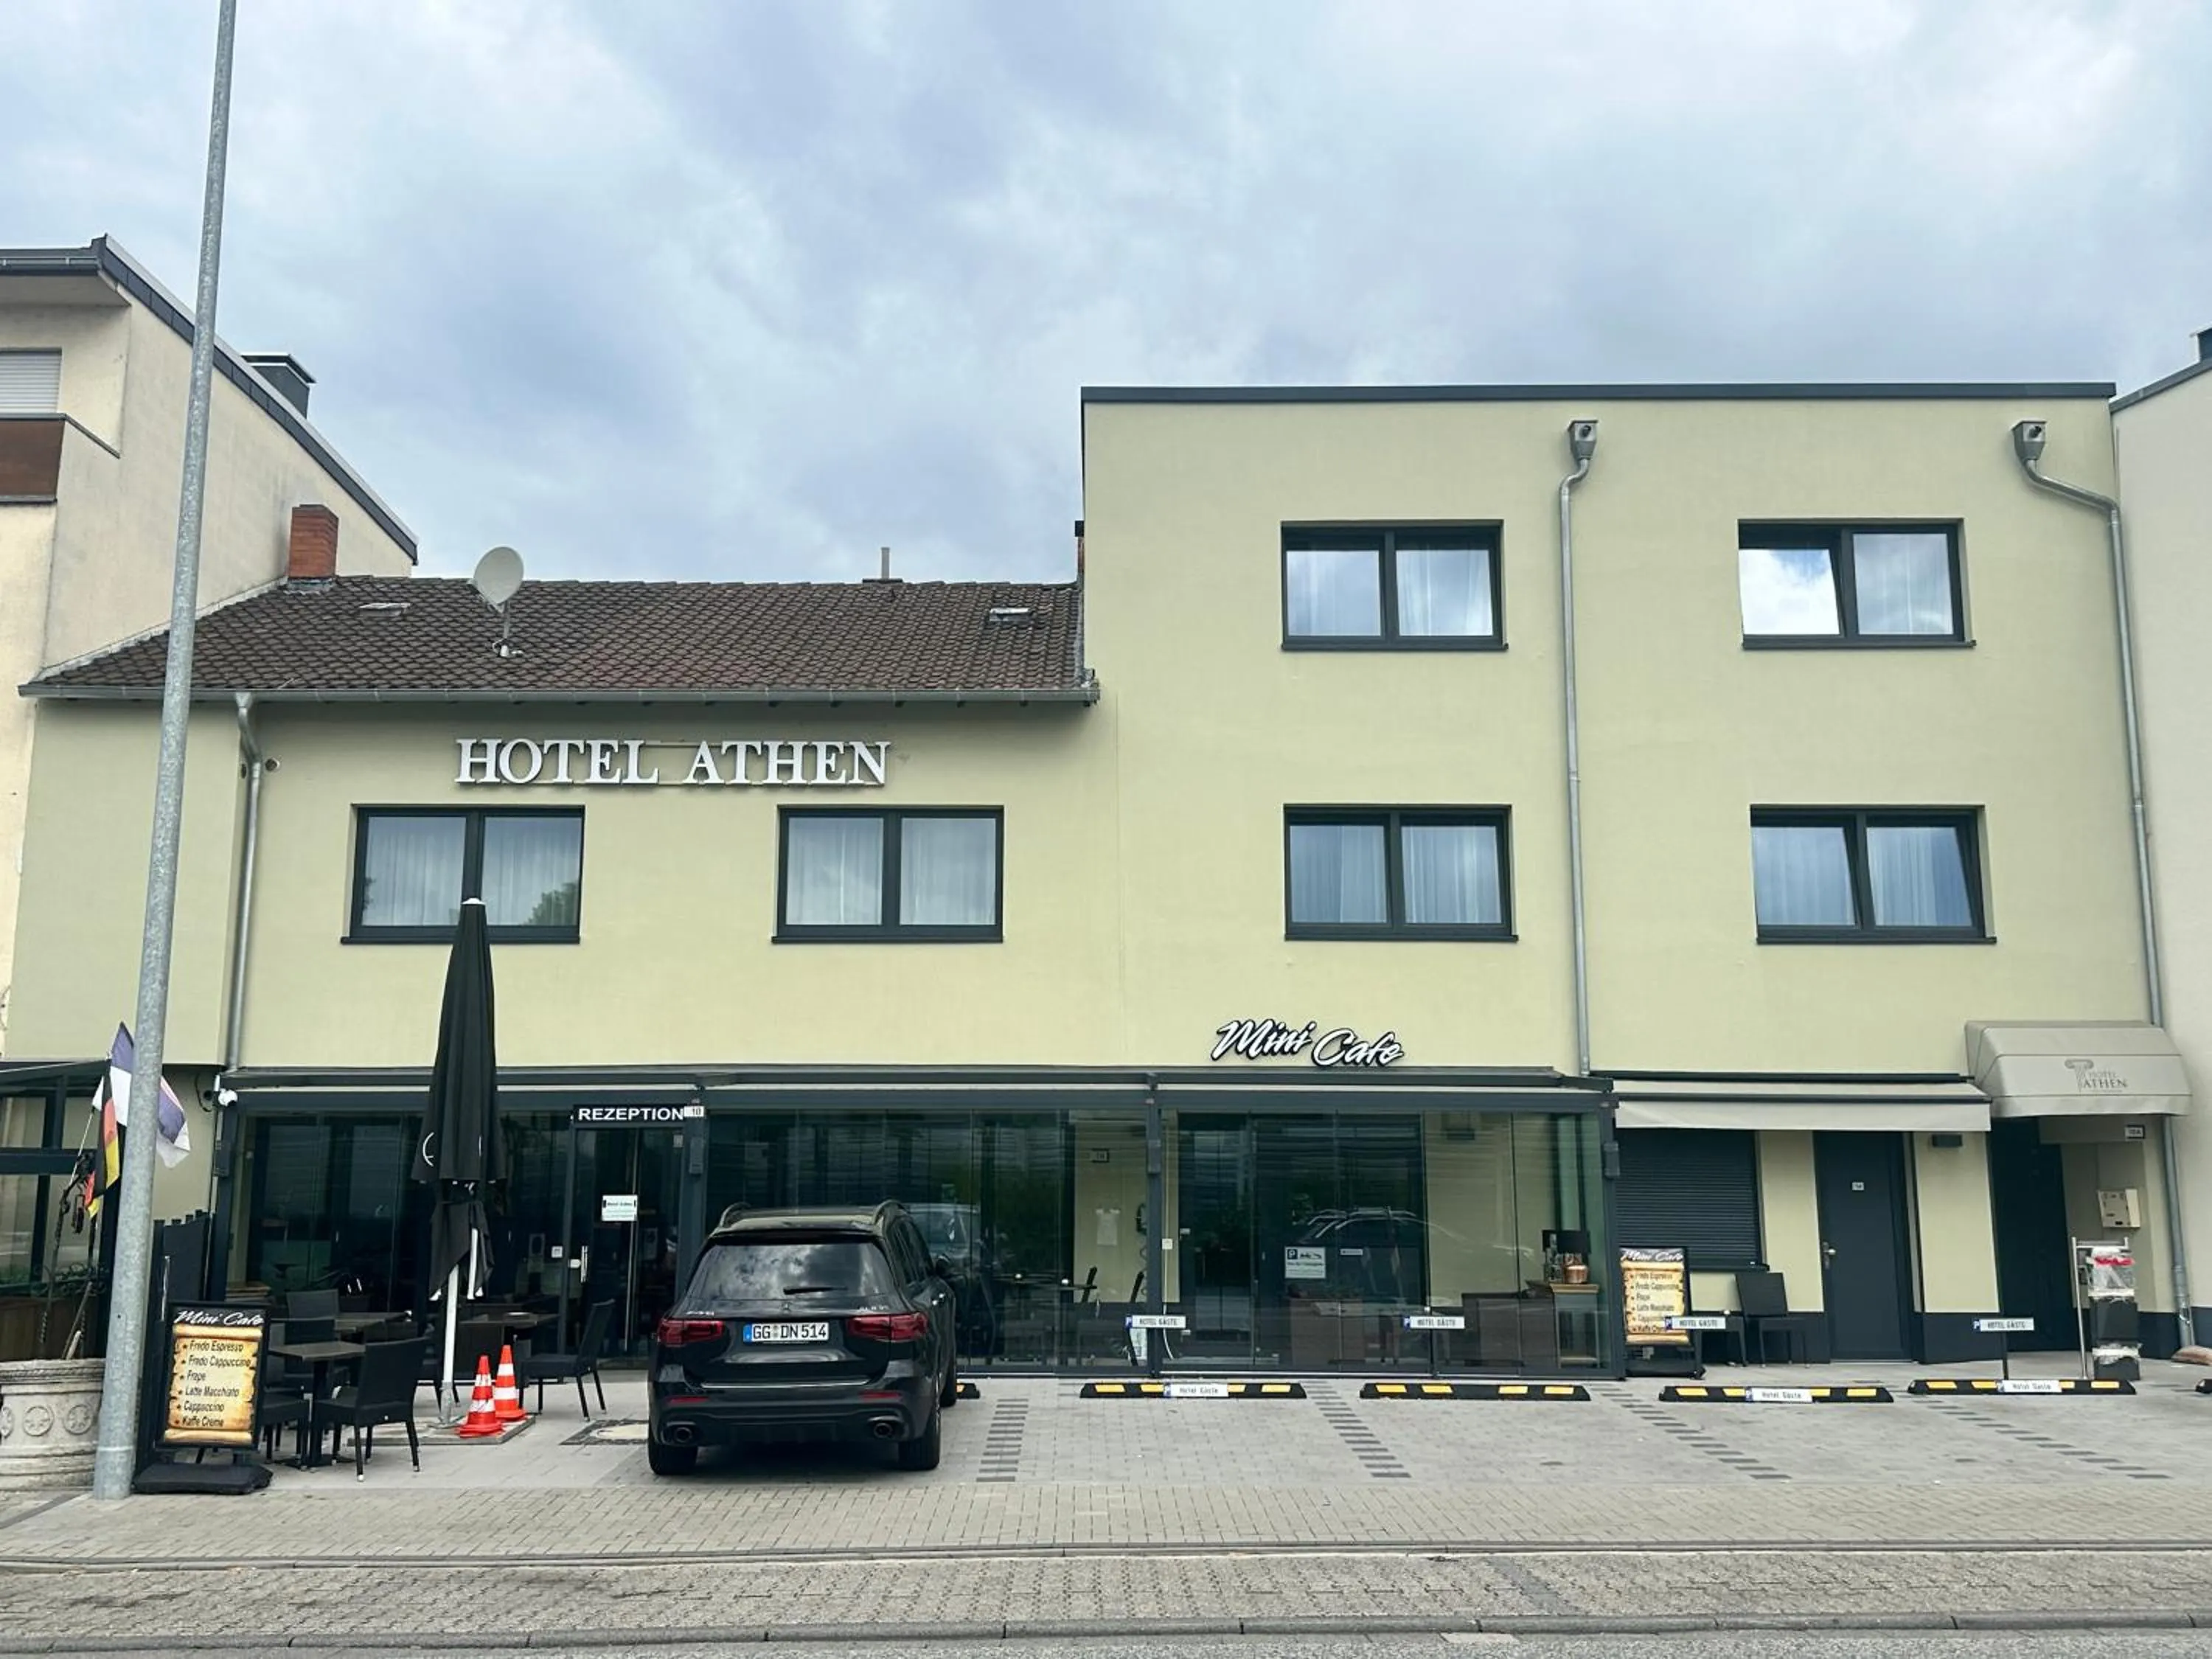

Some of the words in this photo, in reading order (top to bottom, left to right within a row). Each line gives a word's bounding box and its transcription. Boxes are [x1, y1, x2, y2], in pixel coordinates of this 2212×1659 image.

[454, 739, 659, 784] HOTEL
[682, 740, 891, 785] ATHEN
[1211, 1018, 1317, 1061] Mini
[2083, 1079, 2128, 1088] ATHEN
[578, 1108, 684, 1121] REZEPTION
[174, 1311, 222, 1324] Mini
[753, 1325, 771, 1339] GG
[211, 1340, 244, 1354] Espresso
[209, 1356, 251, 1368] Cappuccino
[185, 1386, 203, 1396] Latte
[204, 1387, 240, 1397] Macchiato
[184, 1400, 225, 1413] Cappuccino
